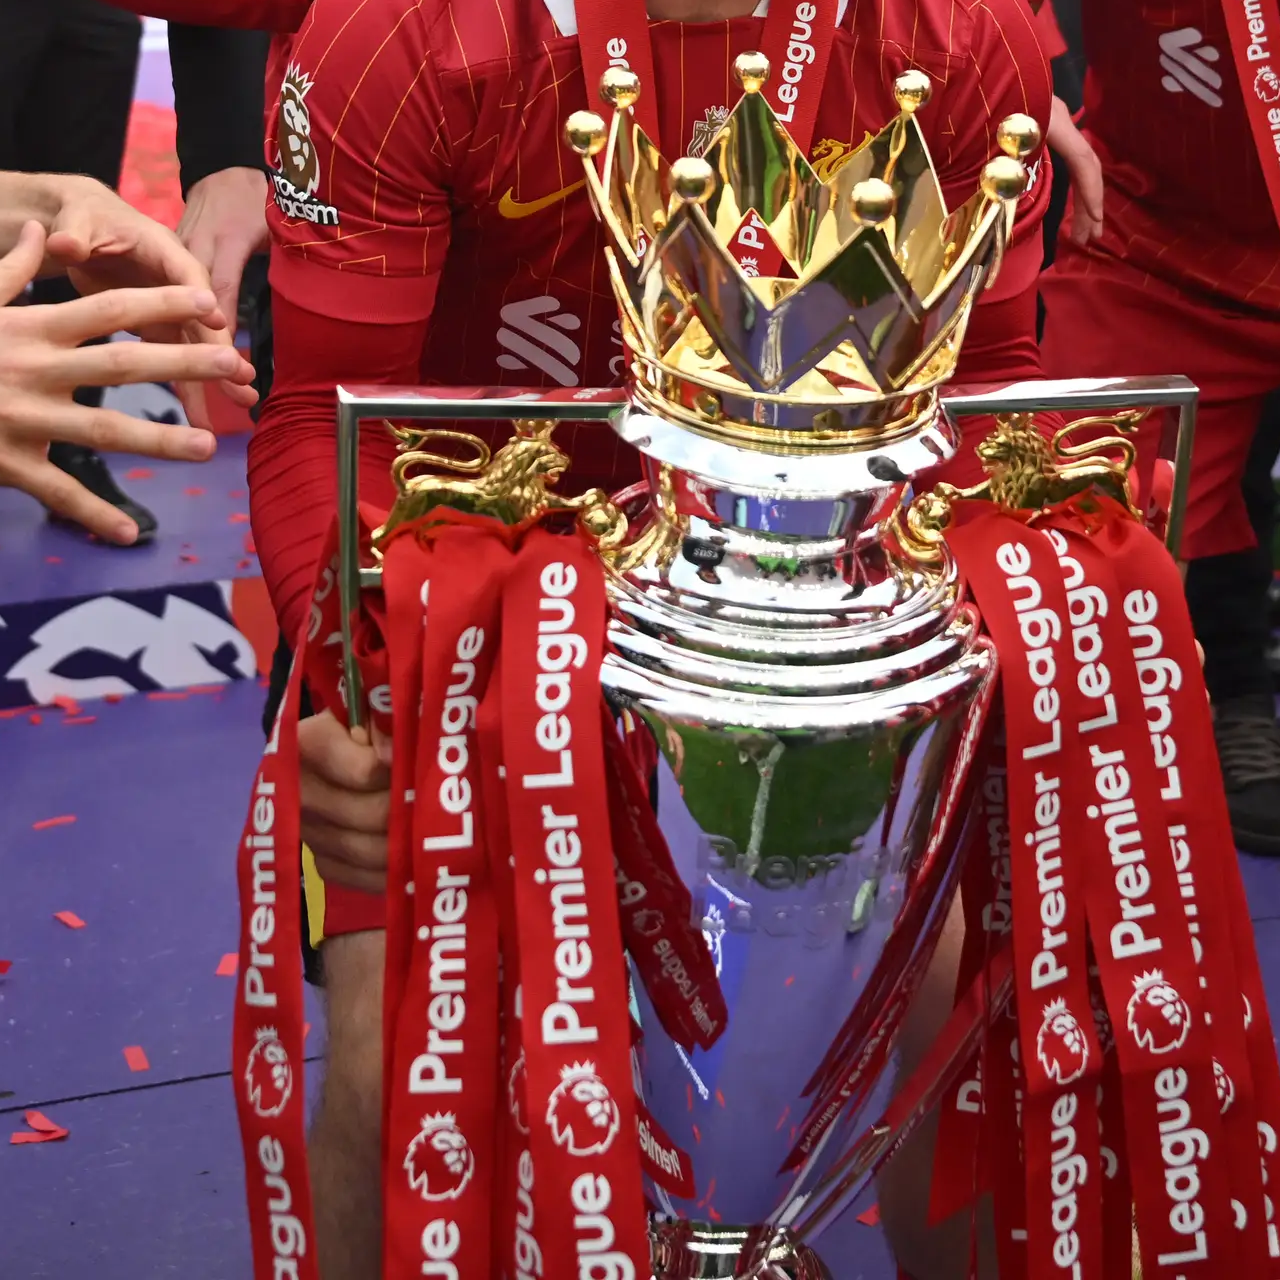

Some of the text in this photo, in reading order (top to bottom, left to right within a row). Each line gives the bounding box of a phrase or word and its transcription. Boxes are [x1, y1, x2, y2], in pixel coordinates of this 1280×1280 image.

[776, 1, 817, 123] League
[245, 773, 277, 1008] Premier
[408, 625, 484, 1094] Premier League
[522, 561, 598, 1046] Premier League
[994, 541, 1068, 991] Premier League
[1041, 528, 1163, 960] Premier League
[1154, 1067, 1210, 1266] League
